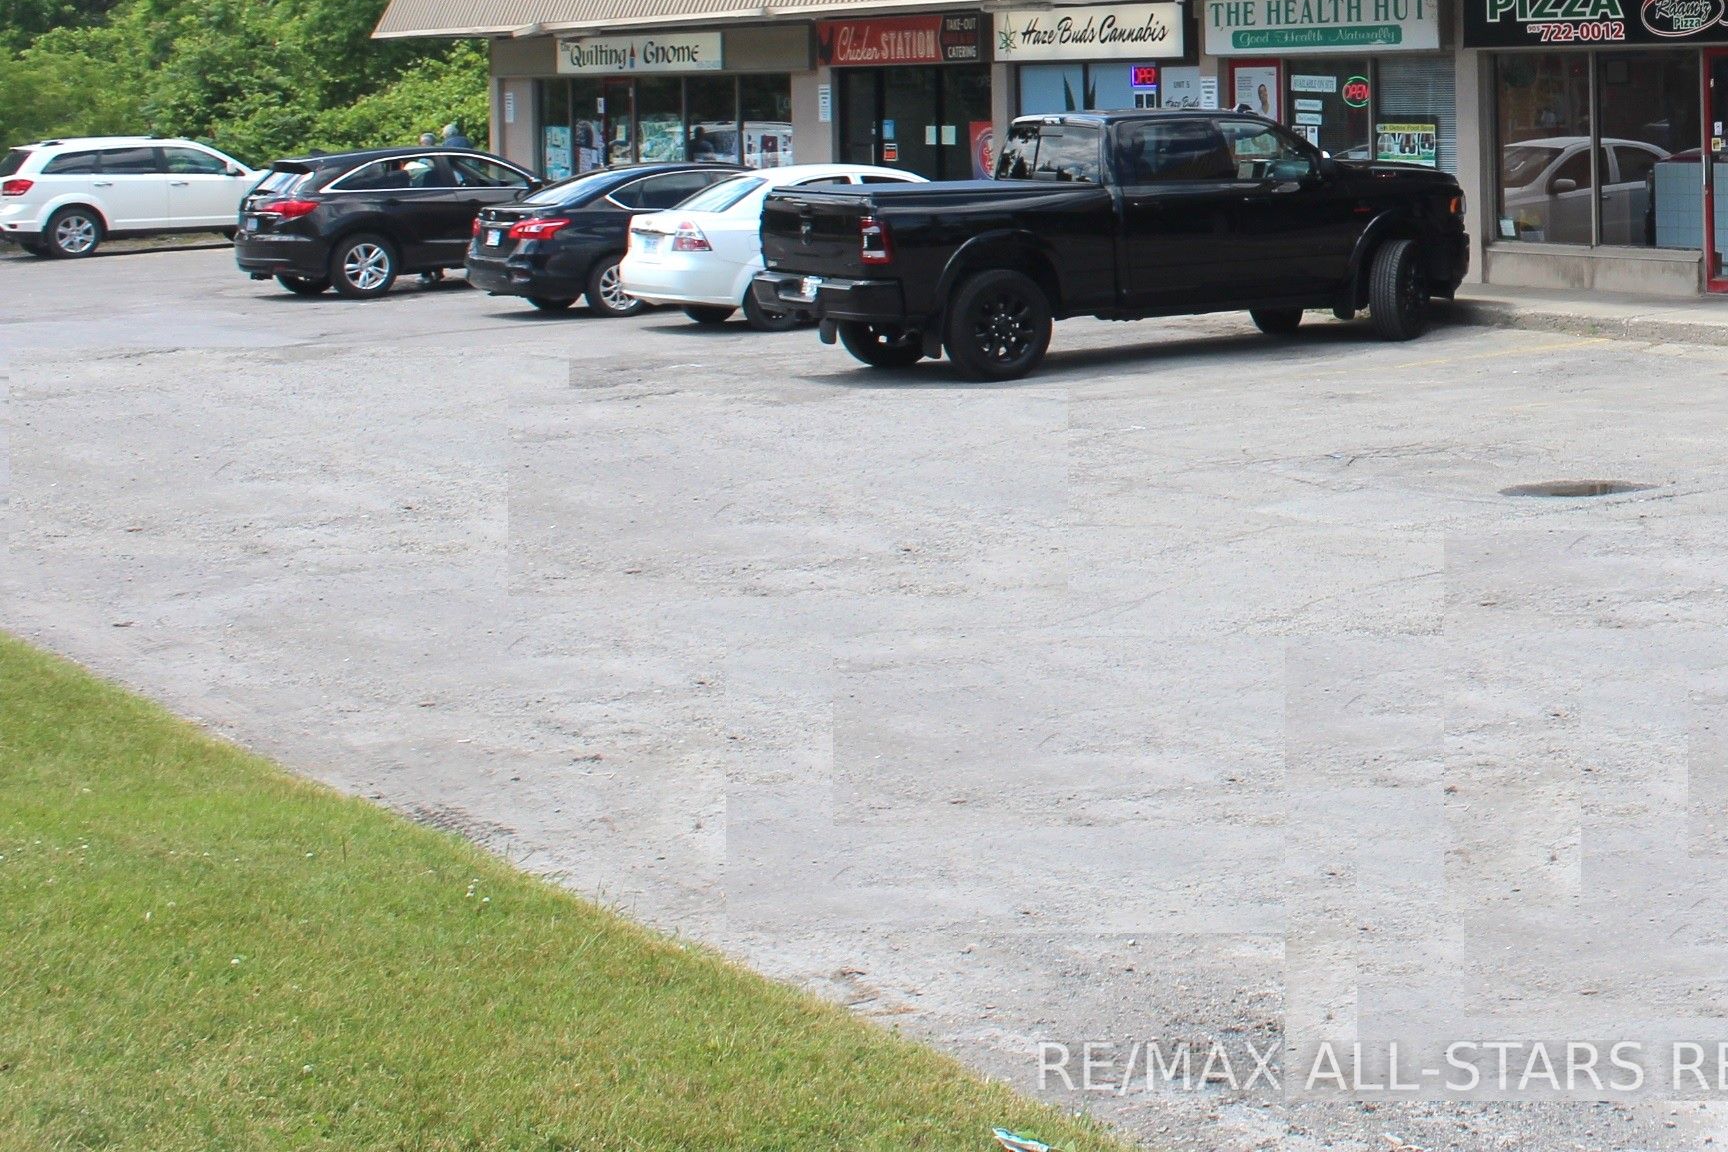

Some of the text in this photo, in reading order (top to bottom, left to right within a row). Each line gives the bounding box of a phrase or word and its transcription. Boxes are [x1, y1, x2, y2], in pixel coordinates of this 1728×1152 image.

[1210, 1, 1256, 27] THE
[1673, 15, 1701, 29] Pizza
[946, 18, 976, 31] TAKE-OUT
[1021, 13, 1168, 45] Haze Buds Cannabis
[1540, 22, 1625, 41] 722-0012
[837, 25, 935, 61] Chicken STATION
[1240, 26, 1395, 46] Good Health Naturally
[571, 41, 699, 69] Quilting Gnome
[948, 46, 977, 58] CATERING
